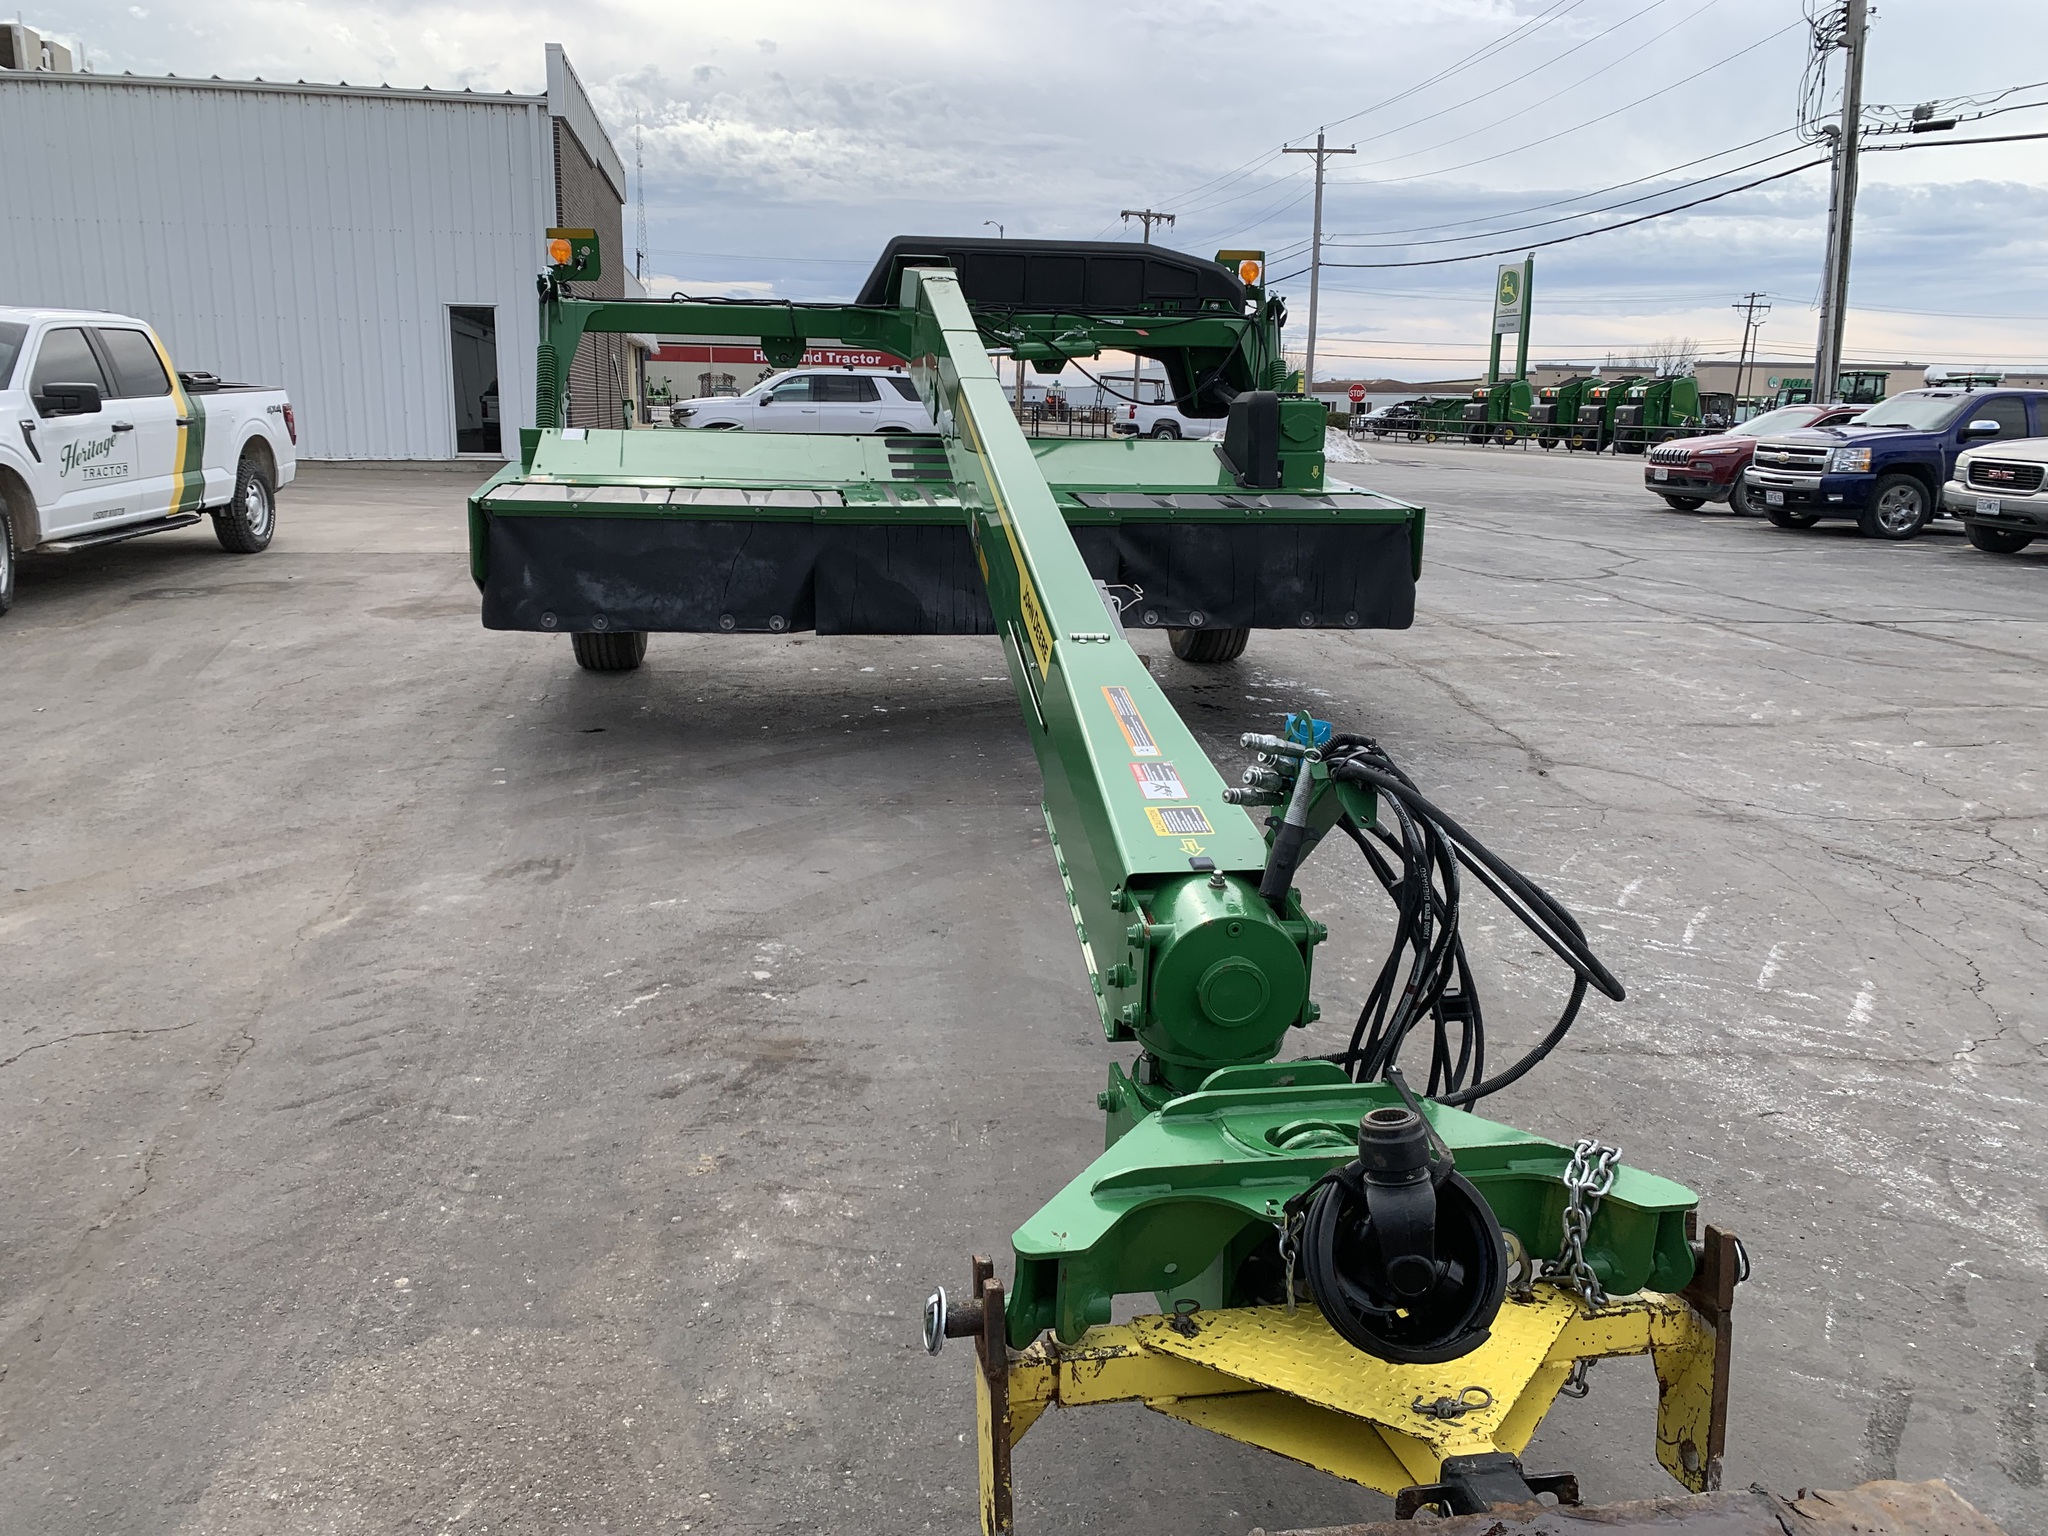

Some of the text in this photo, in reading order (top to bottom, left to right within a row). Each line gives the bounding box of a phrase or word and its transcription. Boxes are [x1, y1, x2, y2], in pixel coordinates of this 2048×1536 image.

[826, 352, 881, 364] Tractor
[1781, 379, 1813, 388] DOLL
[1349, 389, 1365, 398] STOP
[60, 434, 117, 478] Heritage
[82, 465, 129, 478] TRACTOR
[1988, 469, 2016, 480] GMC
[1033, 610, 1049, 663] DEERE
[1419, 867, 1431, 901] DIEHARD
